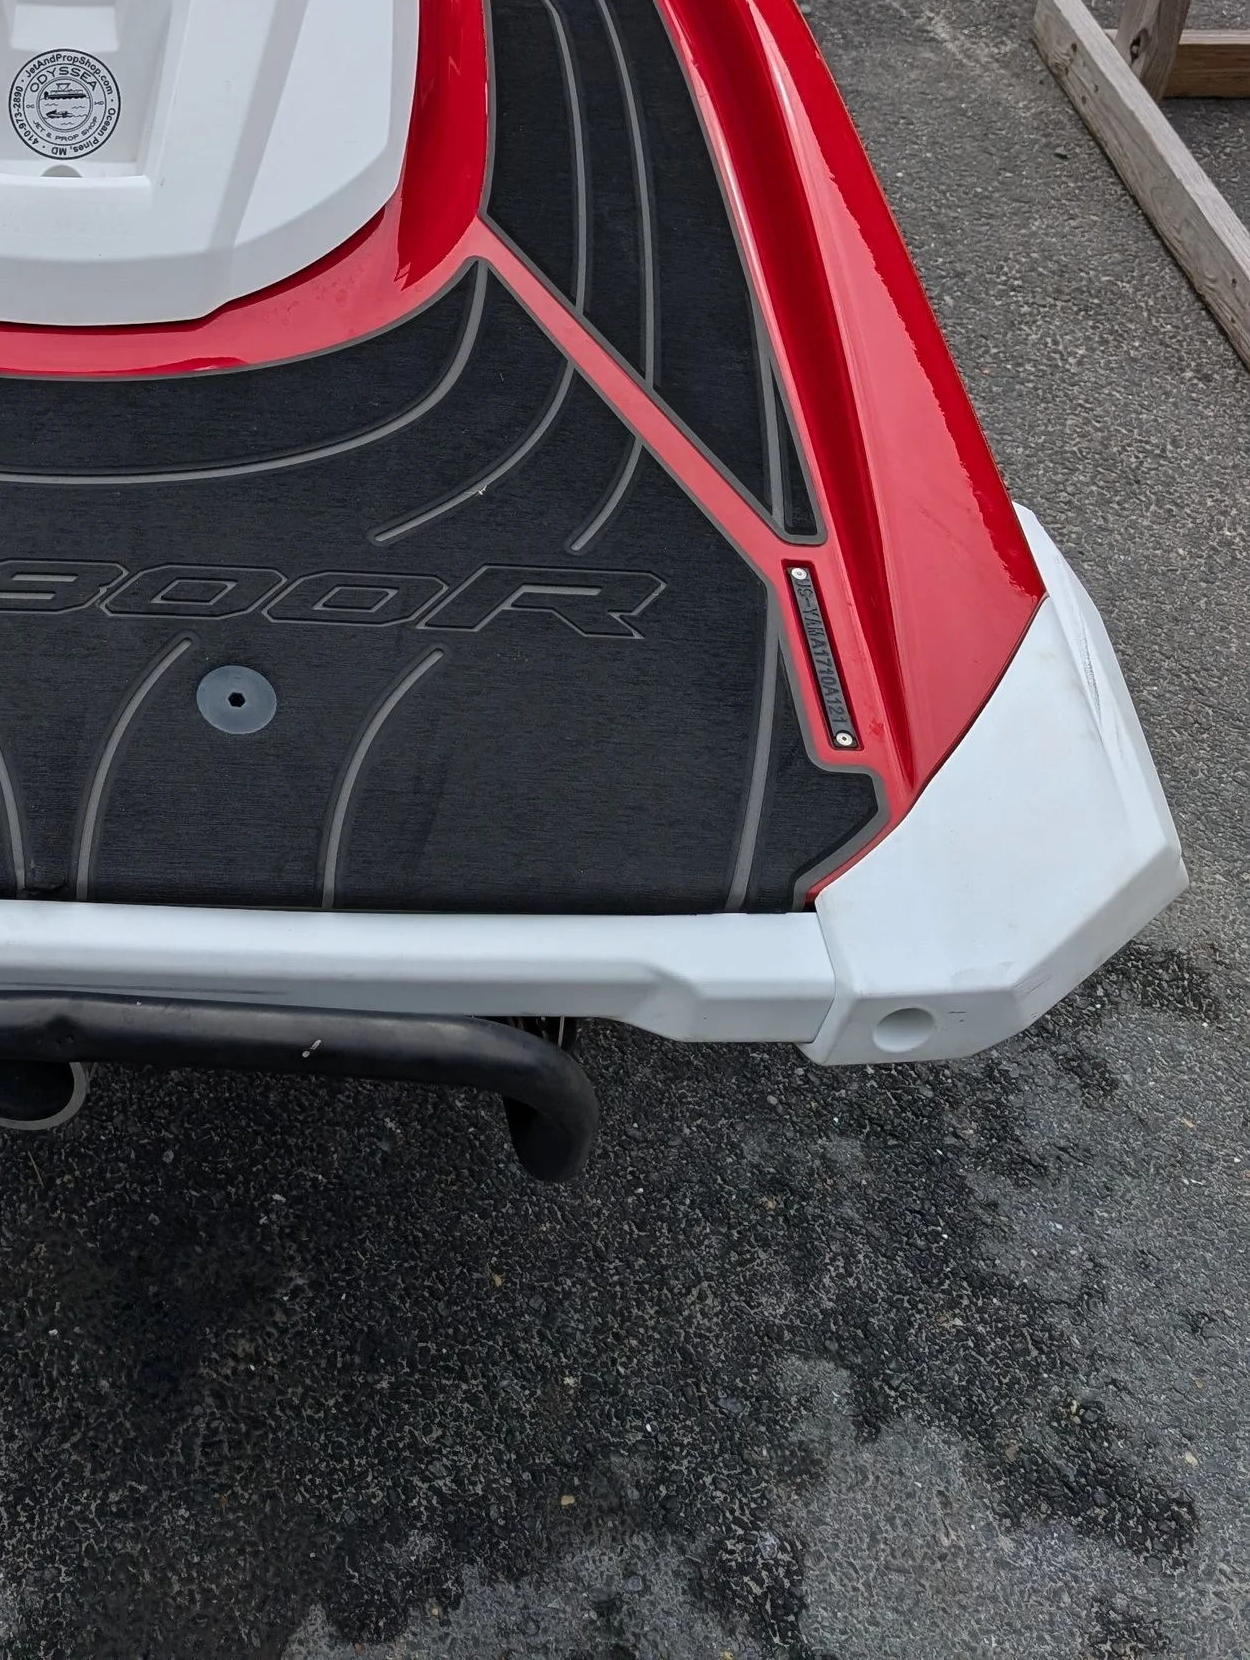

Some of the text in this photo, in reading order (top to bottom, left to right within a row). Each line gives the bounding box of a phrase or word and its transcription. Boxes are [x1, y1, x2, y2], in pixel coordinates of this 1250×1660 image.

[25, 53, 114, 95] JetAndPropShop.com
[30, 66, 98, 93] ODYSSEA
[12, 85, 39, 145] 410-973-2890
[32, 120, 46, 133] JET
[55, 133, 79, 142] PROP
[81, 115, 99, 137] SHOP
[100, 107, 117, 139] Ocean
[51, 145, 67, 156] MD
